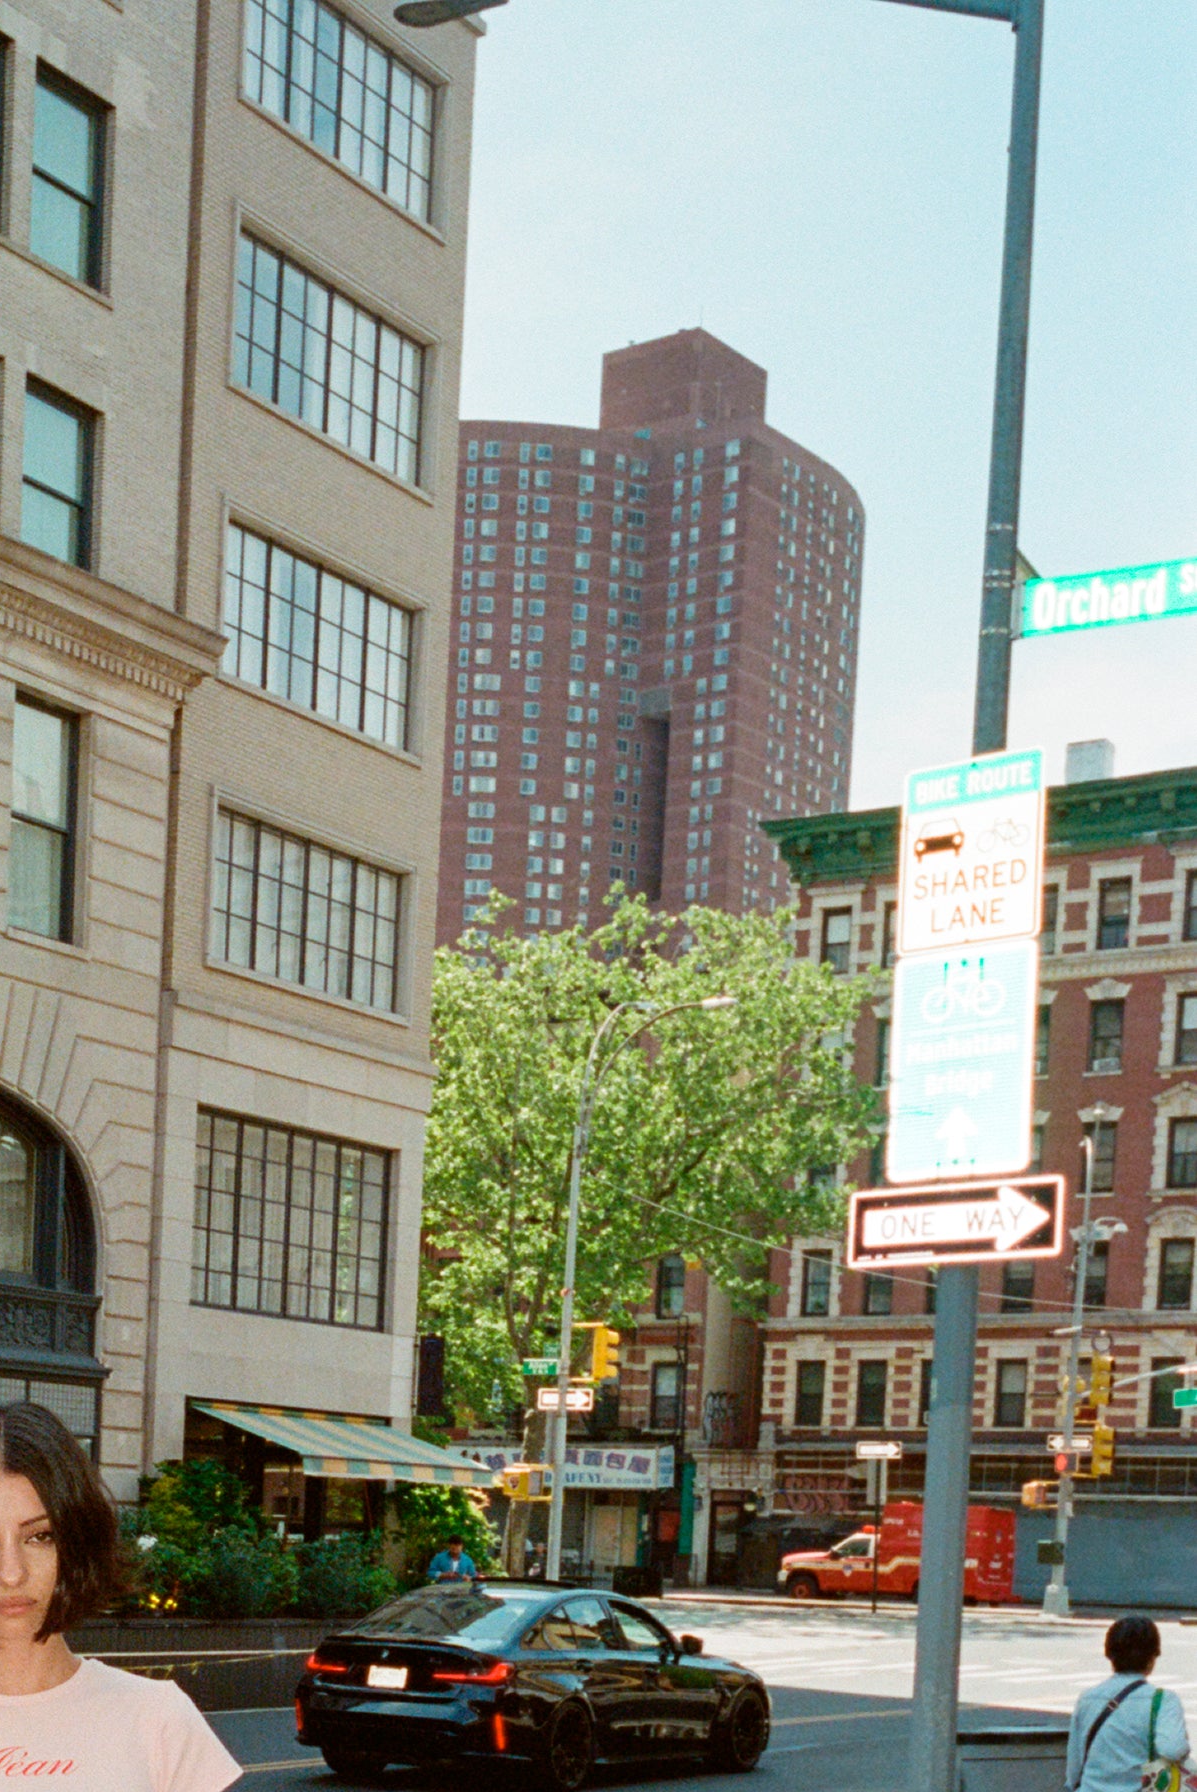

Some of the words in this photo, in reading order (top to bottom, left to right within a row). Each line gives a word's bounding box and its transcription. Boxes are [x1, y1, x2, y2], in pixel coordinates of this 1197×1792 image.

[1033, 568, 1168, 630] Orchard
[1180, 563, 1197, 594] S
[914, 774, 961, 806] BIKE
[966, 759, 1033, 795] ROUTE
[913, 858, 1027, 901] SHARED
[930, 897, 1005, 933] LANE
[880, 1211, 935, 1240] ONE
[965, 1205, 1025, 1233] WAY
